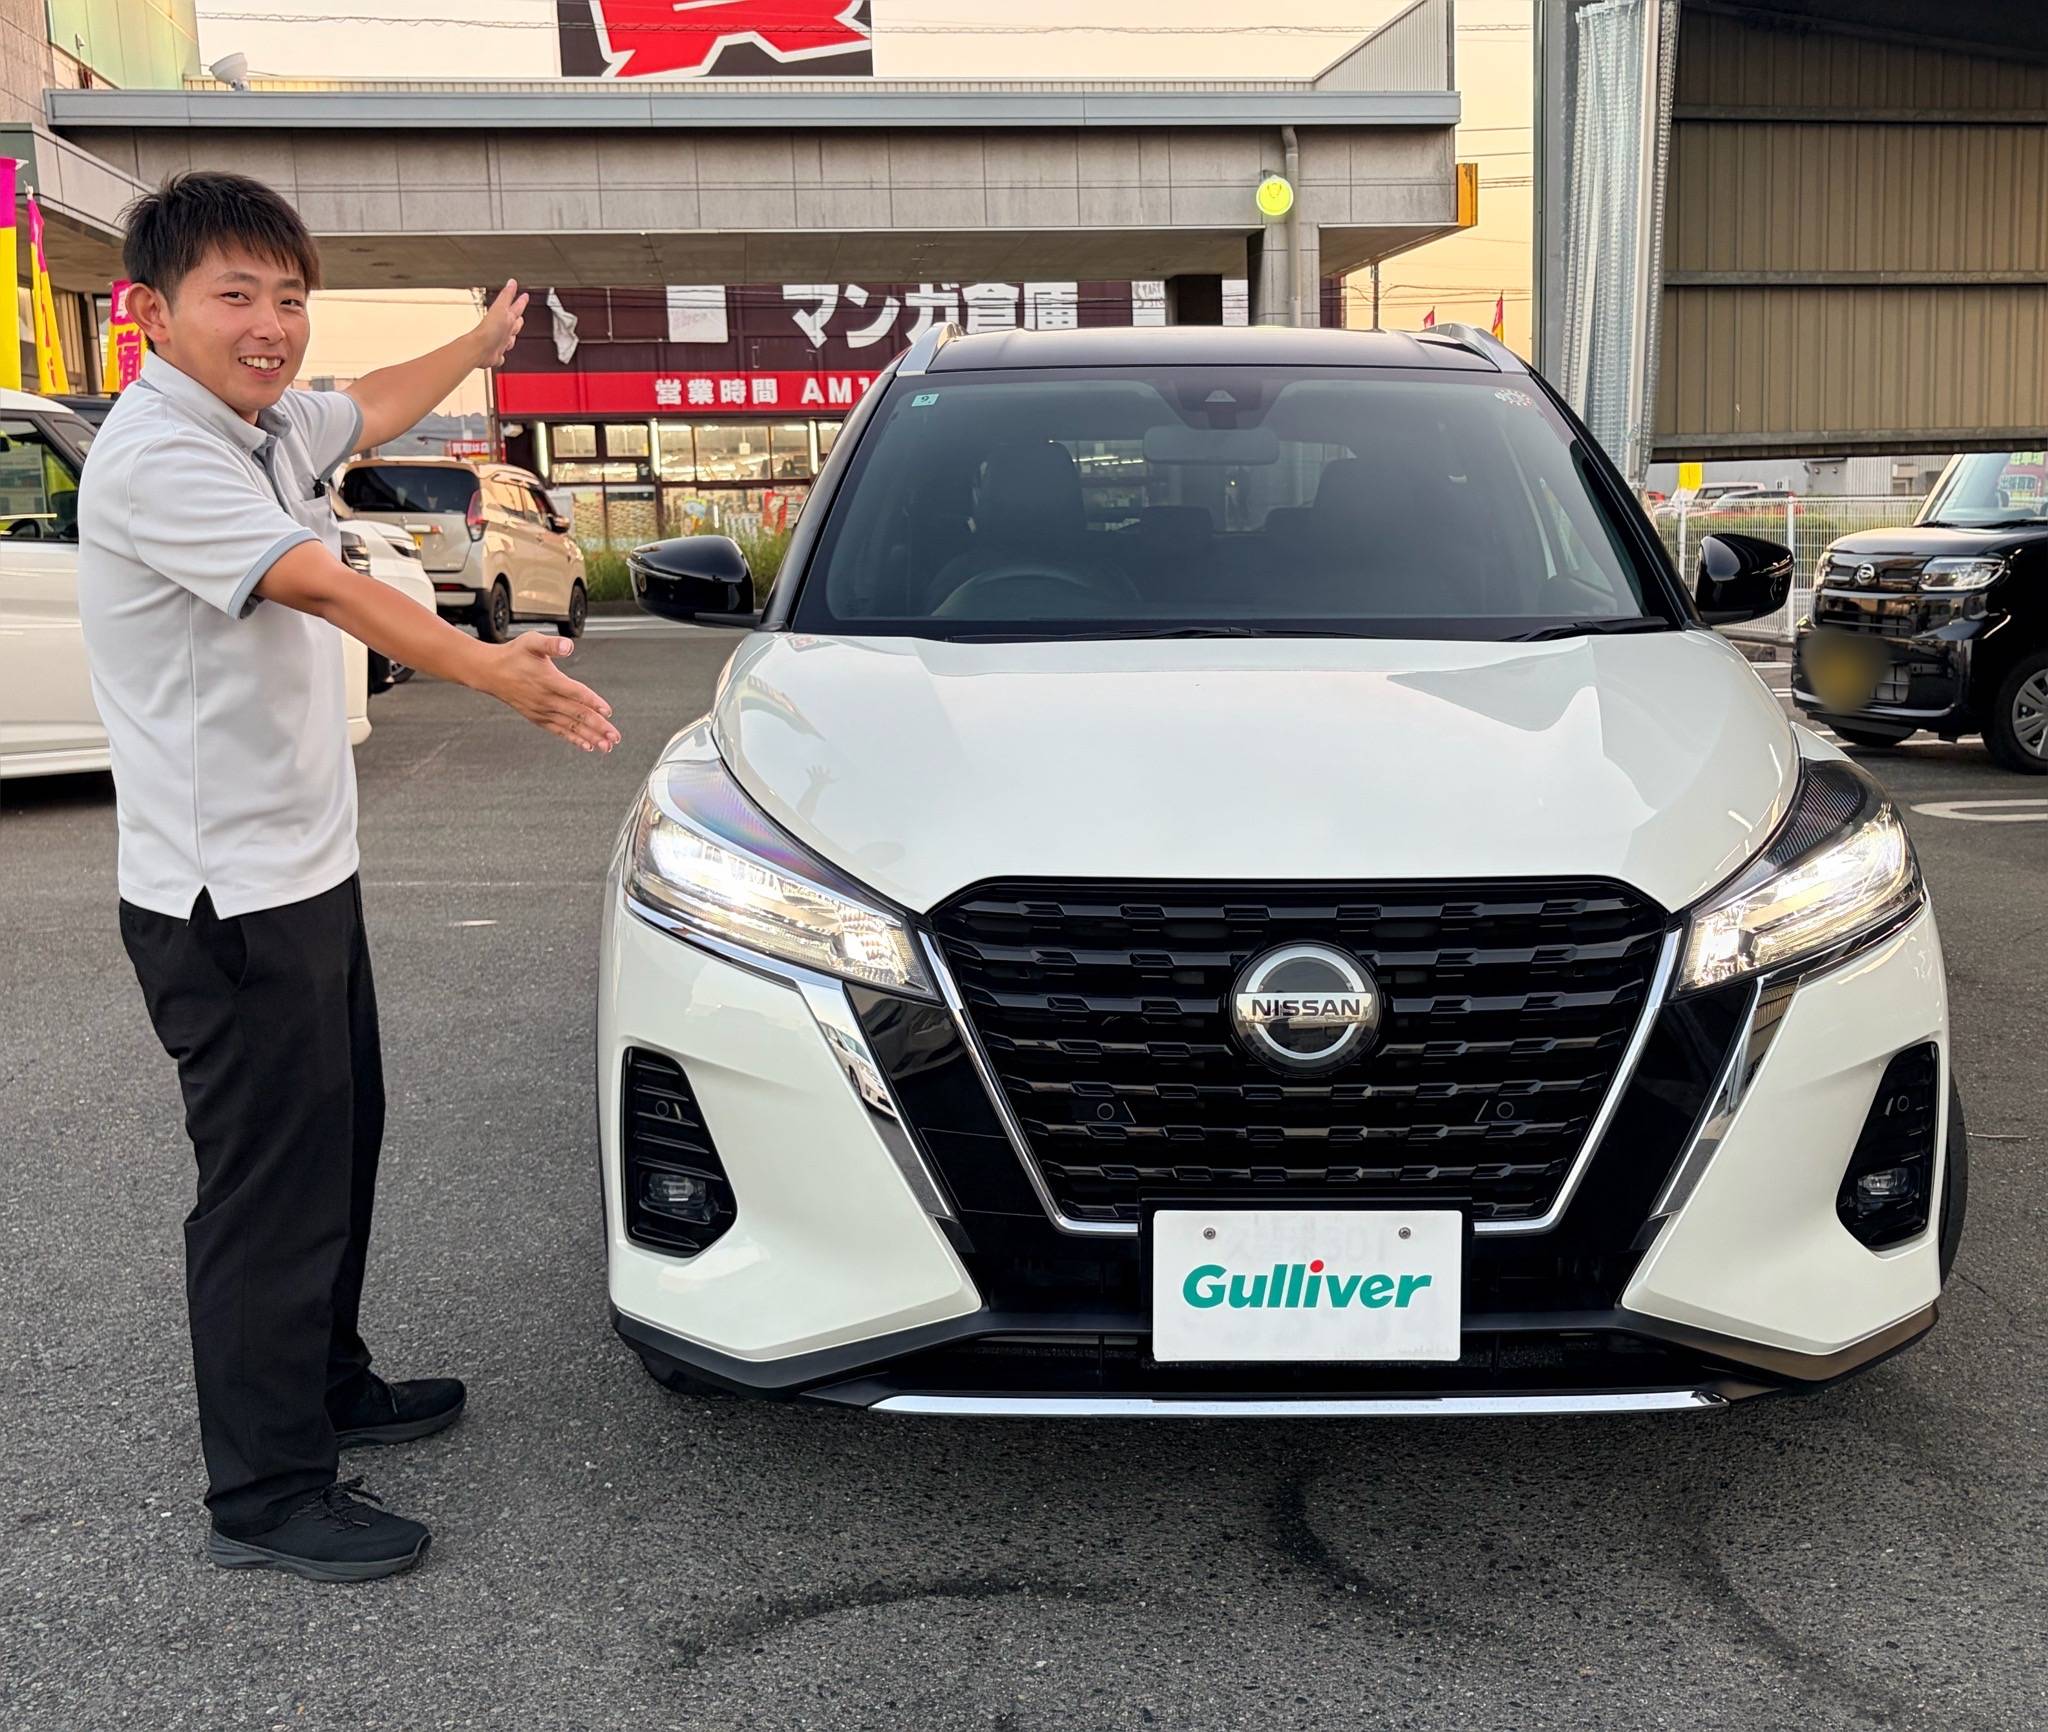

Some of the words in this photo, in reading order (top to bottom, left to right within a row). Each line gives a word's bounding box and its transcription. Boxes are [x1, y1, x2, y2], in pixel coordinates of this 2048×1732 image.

[782, 282, 1078, 348] マンガ倉庫
[655, 378, 778, 405] 営業時間
[1251, 998, 1361, 1017] NISSAN
[1182, 1259, 1433, 1309] Gulliver
